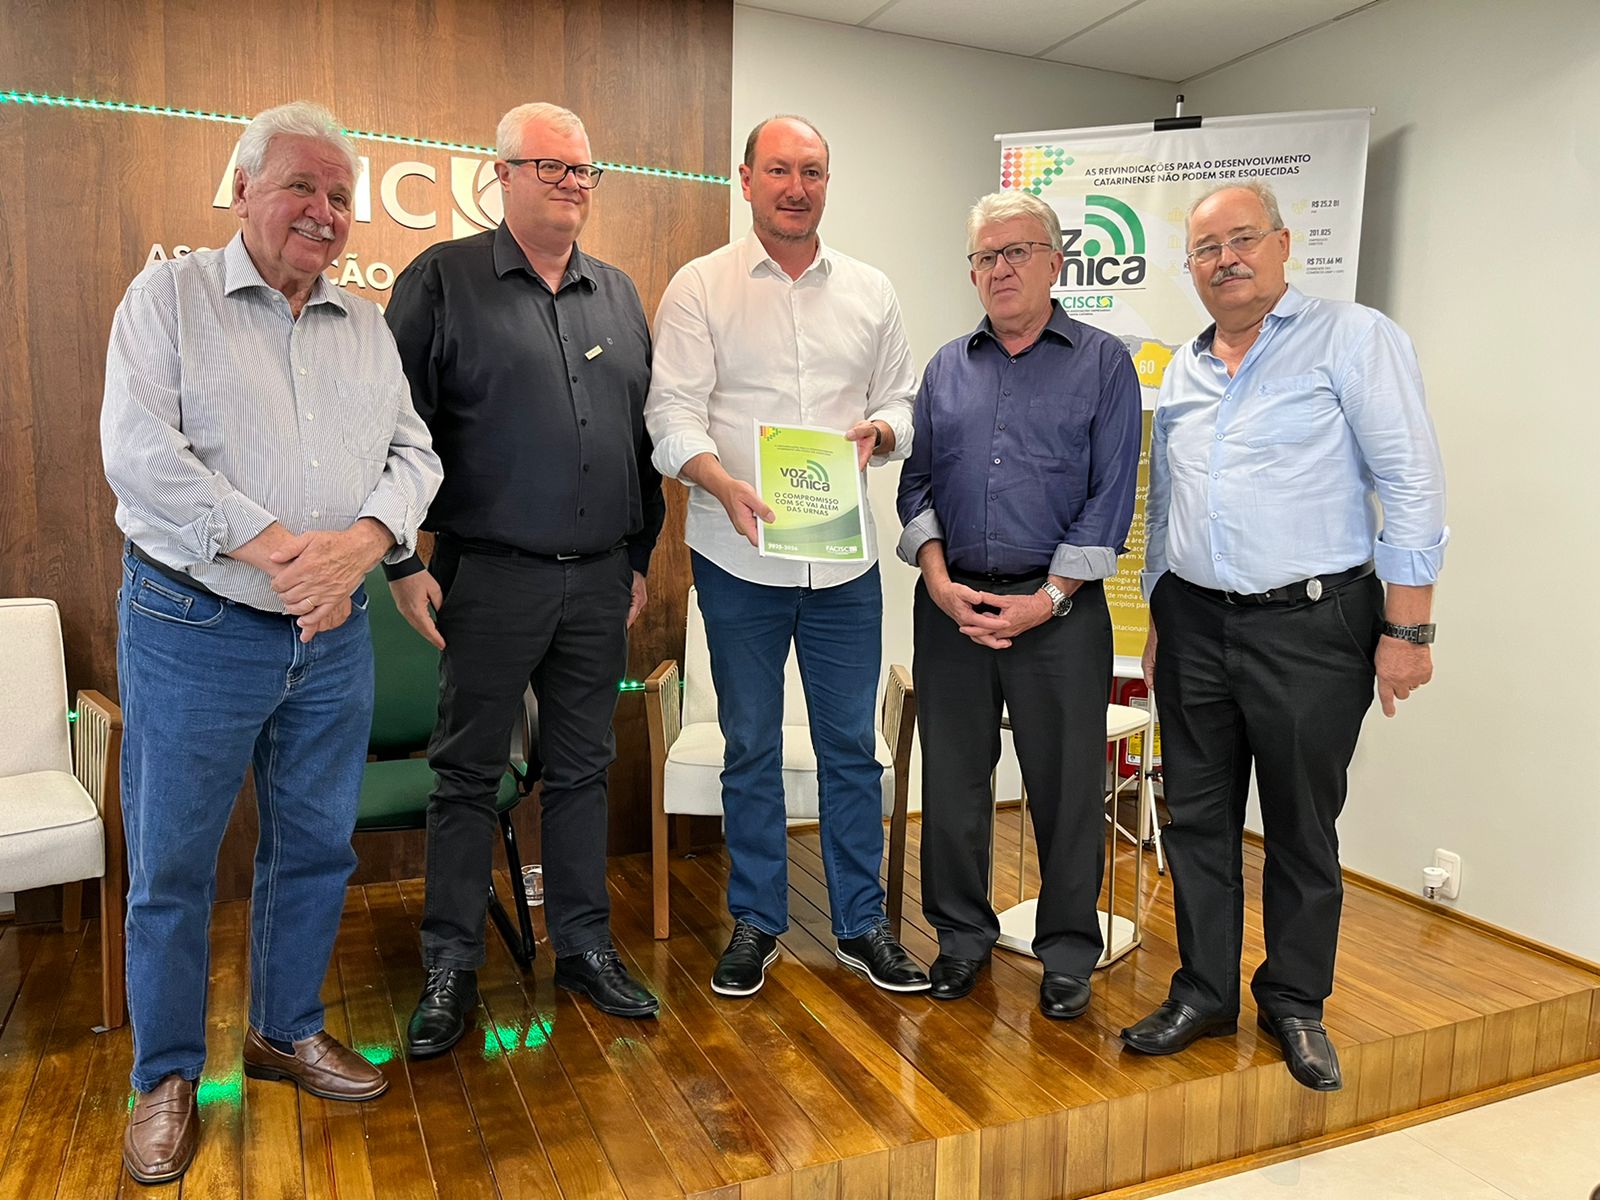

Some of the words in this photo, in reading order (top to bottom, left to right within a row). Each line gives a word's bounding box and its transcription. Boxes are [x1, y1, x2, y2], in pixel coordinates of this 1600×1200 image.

[1085, 168, 1097, 177] AS
[1098, 162, 1175, 176] REIVINDICAÇÕES
[1177, 161, 1201, 171] PARA
[1203, 160, 1212, 169] O
[1214, 153, 1311, 169] DESENVOLVIMENTO
[1093, 175, 1155, 187] CATARINENSE
[1157, 171, 1180, 182] NÃO
[1182, 171, 1216, 181] PODEM
[1218, 170, 1236, 179] SER
[1238, 165, 1300, 178] ESQUECIDAS
[1060, 255, 1146, 287] nica
[1139, 360, 1155, 375] 60
[775, 498, 794, 506] COM
[806, 501, 819, 509] VAI
[782, 492, 839, 505] COMPROMISSO
[786, 505, 802, 513] DAS
[803, 507, 829, 516] URNAS
